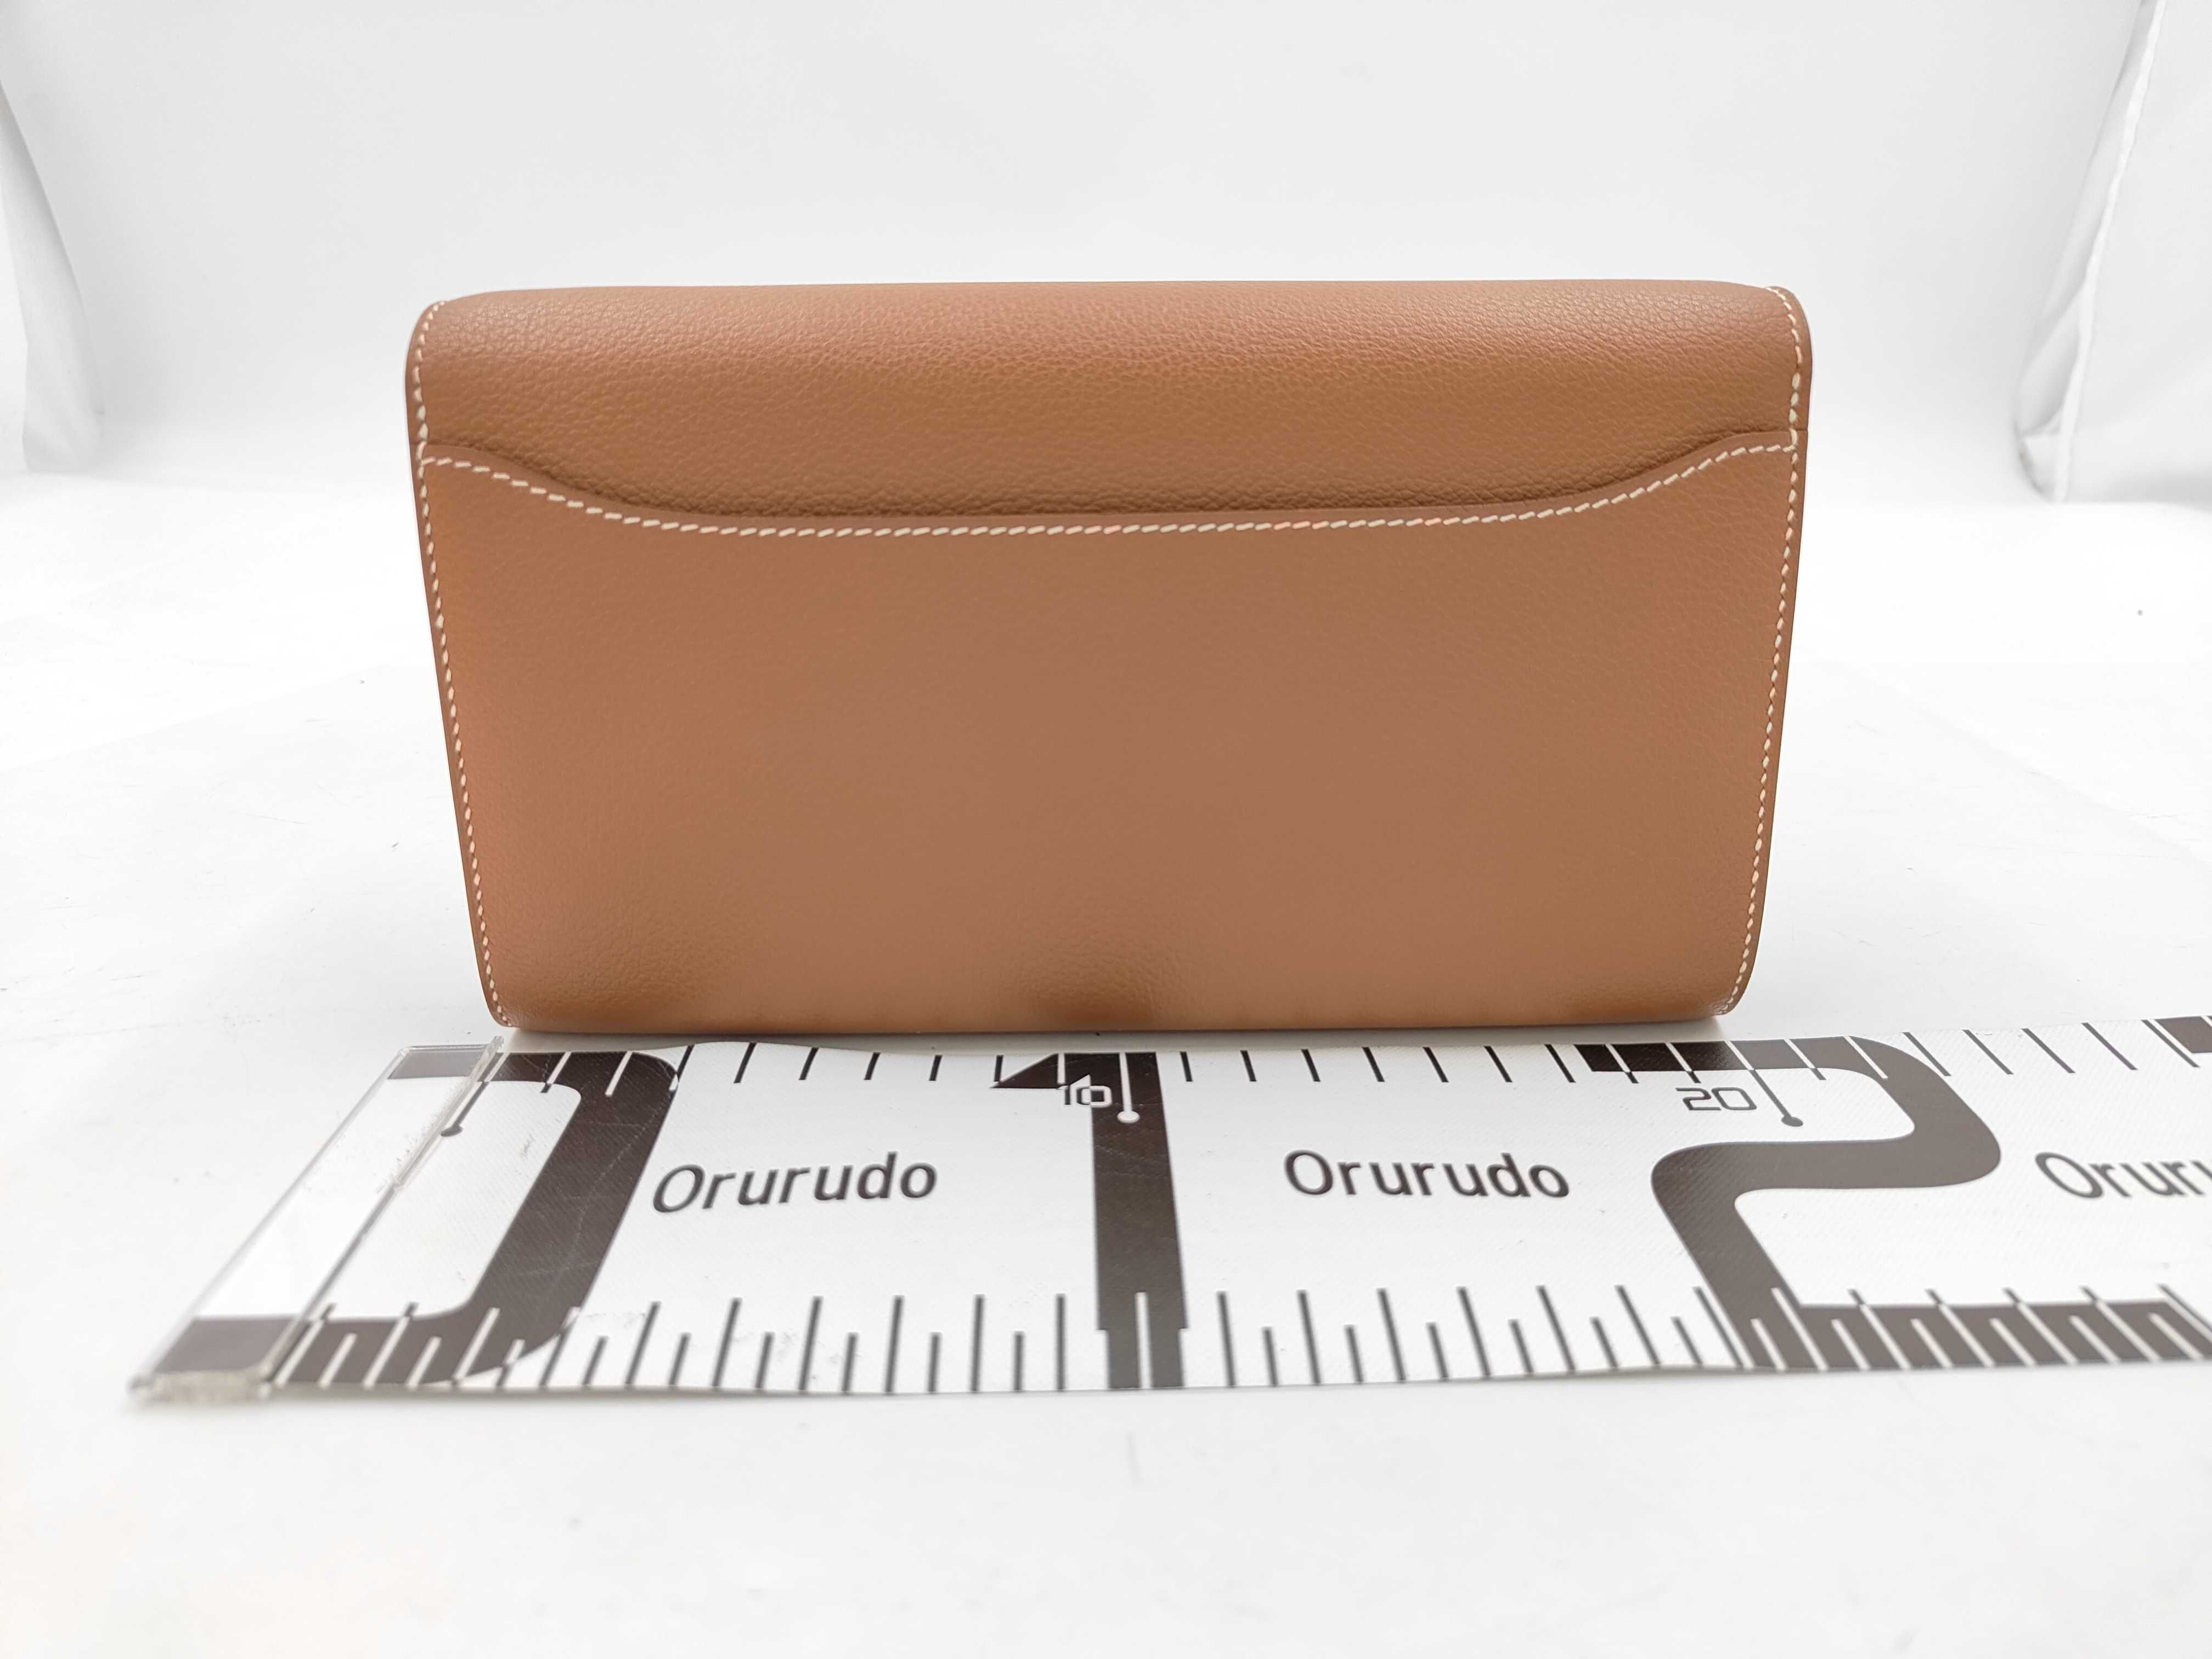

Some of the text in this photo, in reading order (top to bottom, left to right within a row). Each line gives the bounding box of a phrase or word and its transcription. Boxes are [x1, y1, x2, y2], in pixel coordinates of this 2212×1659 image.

[1056, 1085, 1113, 1108] 10
[1675, 1087, 1757, 1111] 20
[653, 1152, 937, 1214] Orurudo
[1284, 1150, 1570, 1199] Orurudo
[990, 1052, 1188, 1389] 1
[1573, 1036, 2212, 1372] 2
